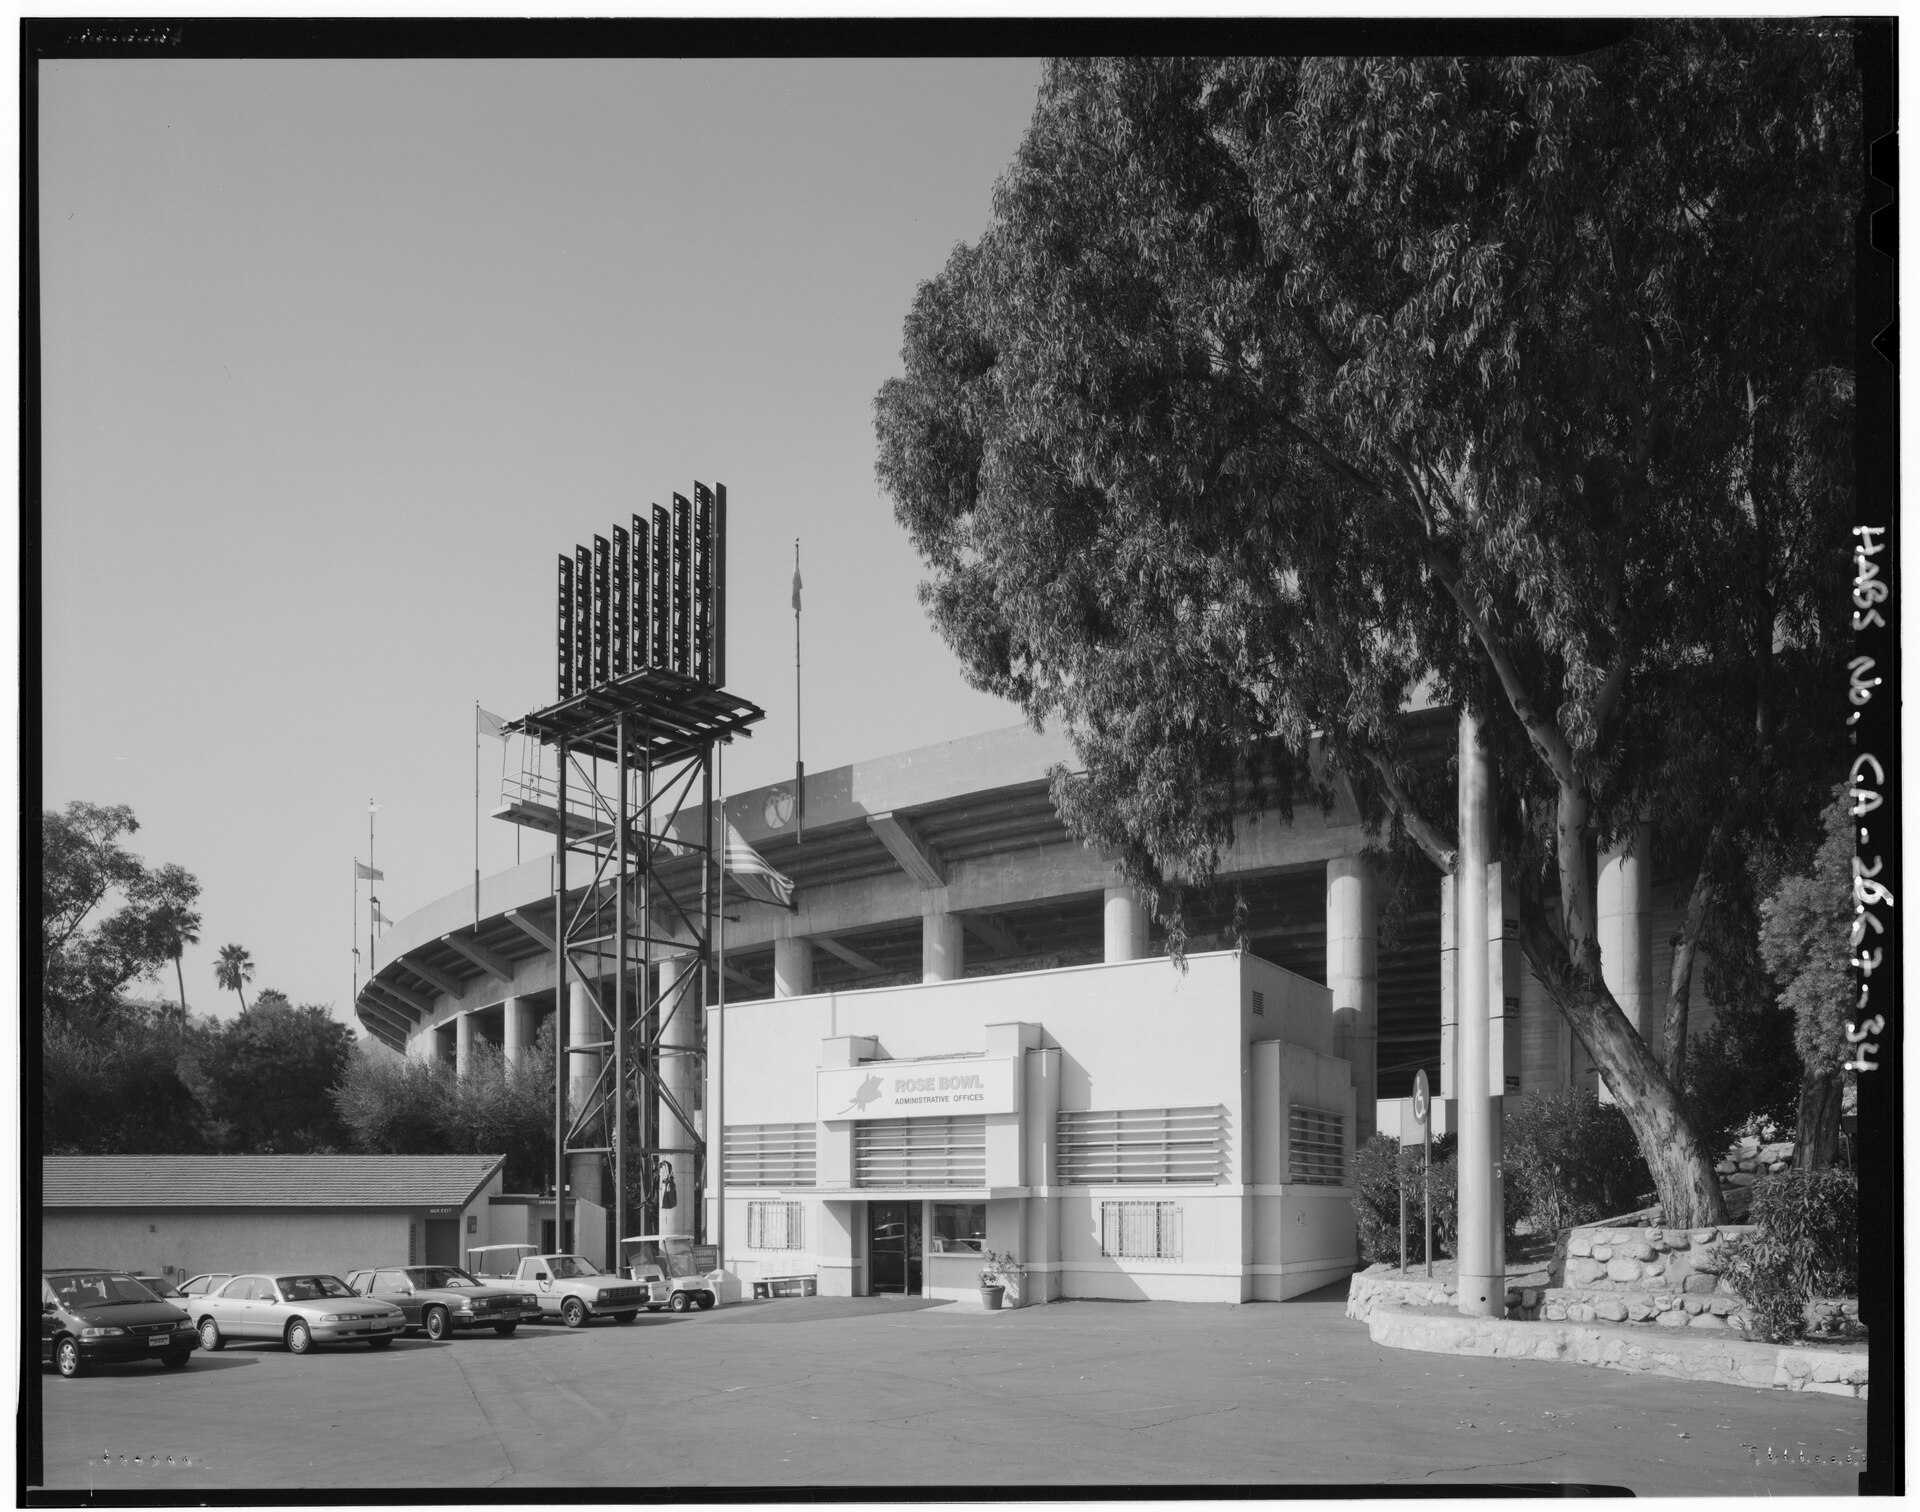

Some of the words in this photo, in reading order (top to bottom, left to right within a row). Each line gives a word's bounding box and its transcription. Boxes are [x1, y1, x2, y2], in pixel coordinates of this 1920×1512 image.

[1852, 525, 1889, 631] HABS
[894, 1077, 936, 1093] ROSE
[938, 1074, 984, 1091] BOWL
[894, 1095, 950, 1105] ADMINISTRATIVE
[953, 1093, 984, 1102] OFFICES
